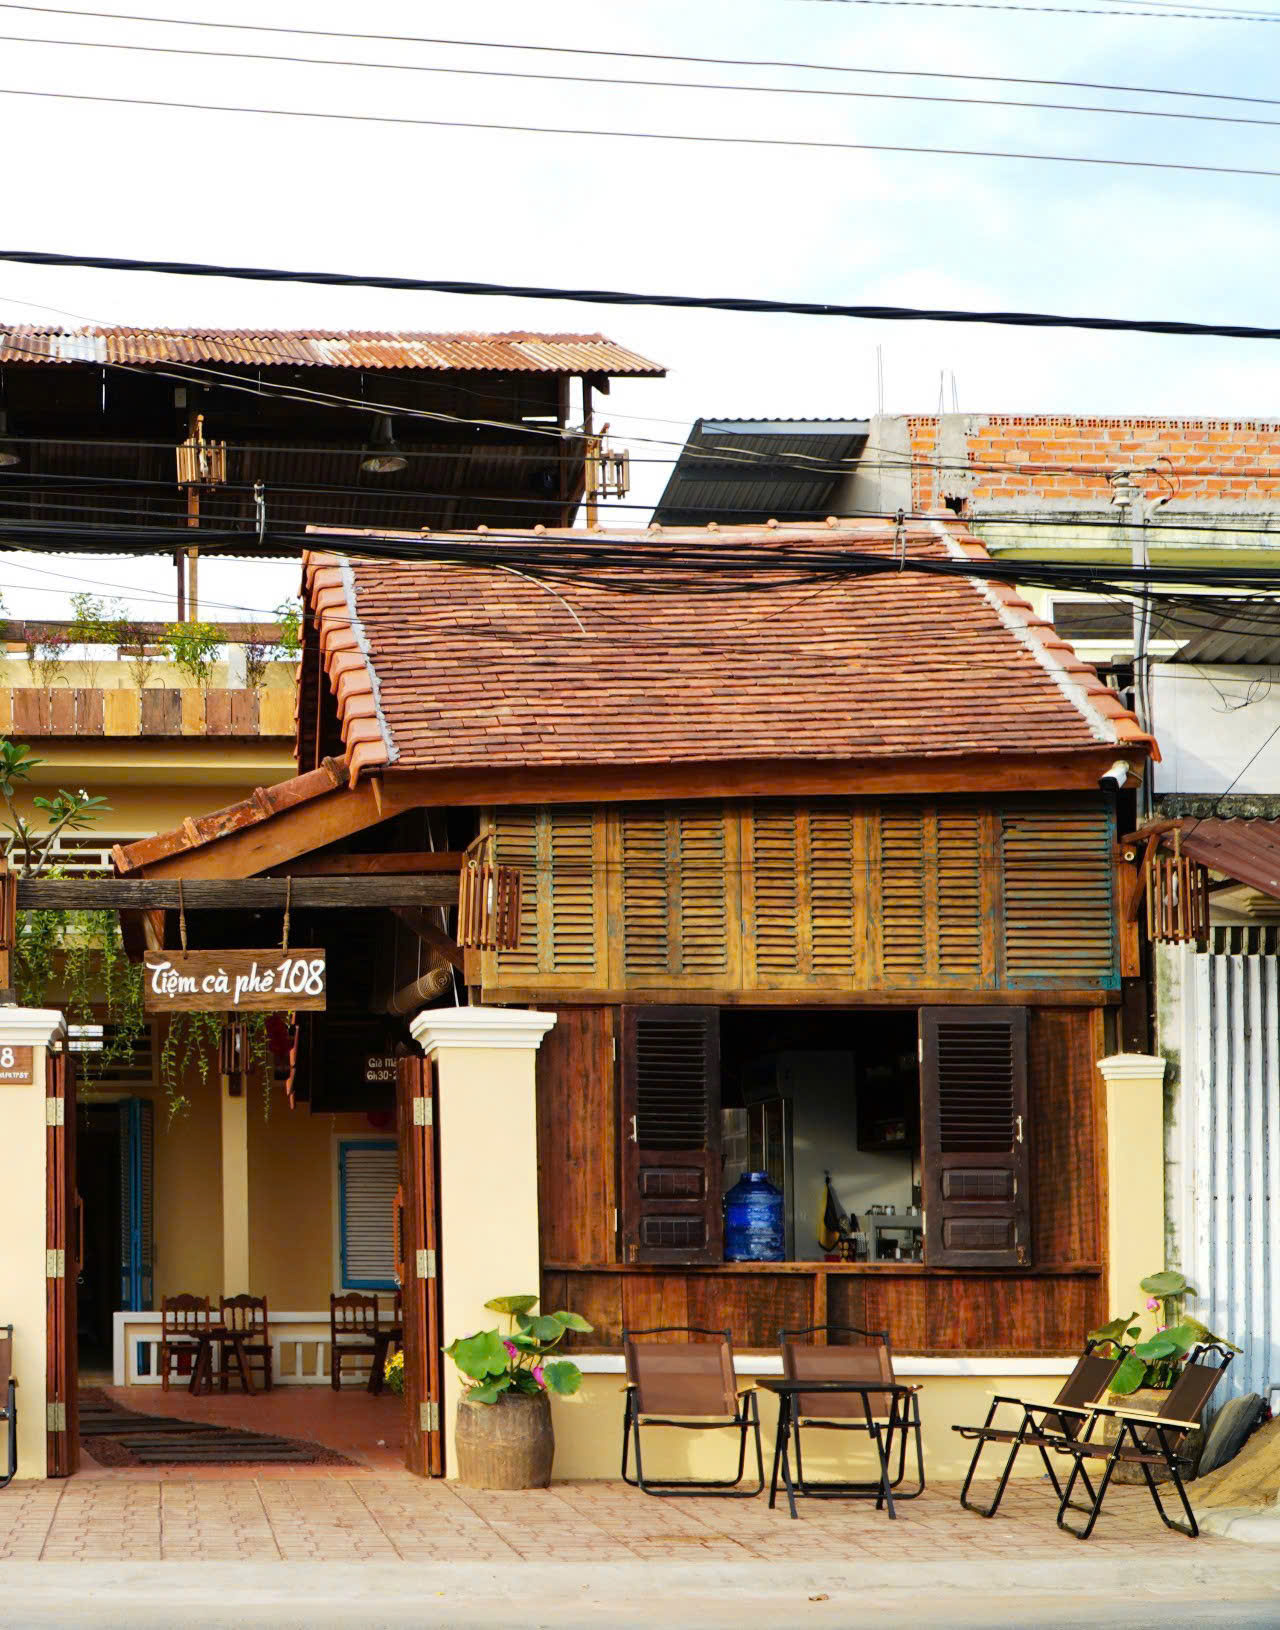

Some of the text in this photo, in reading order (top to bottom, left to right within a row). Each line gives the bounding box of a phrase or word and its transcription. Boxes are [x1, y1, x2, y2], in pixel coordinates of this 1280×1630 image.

[146, 958, 326, 1004] Tiệm cà phê 108
